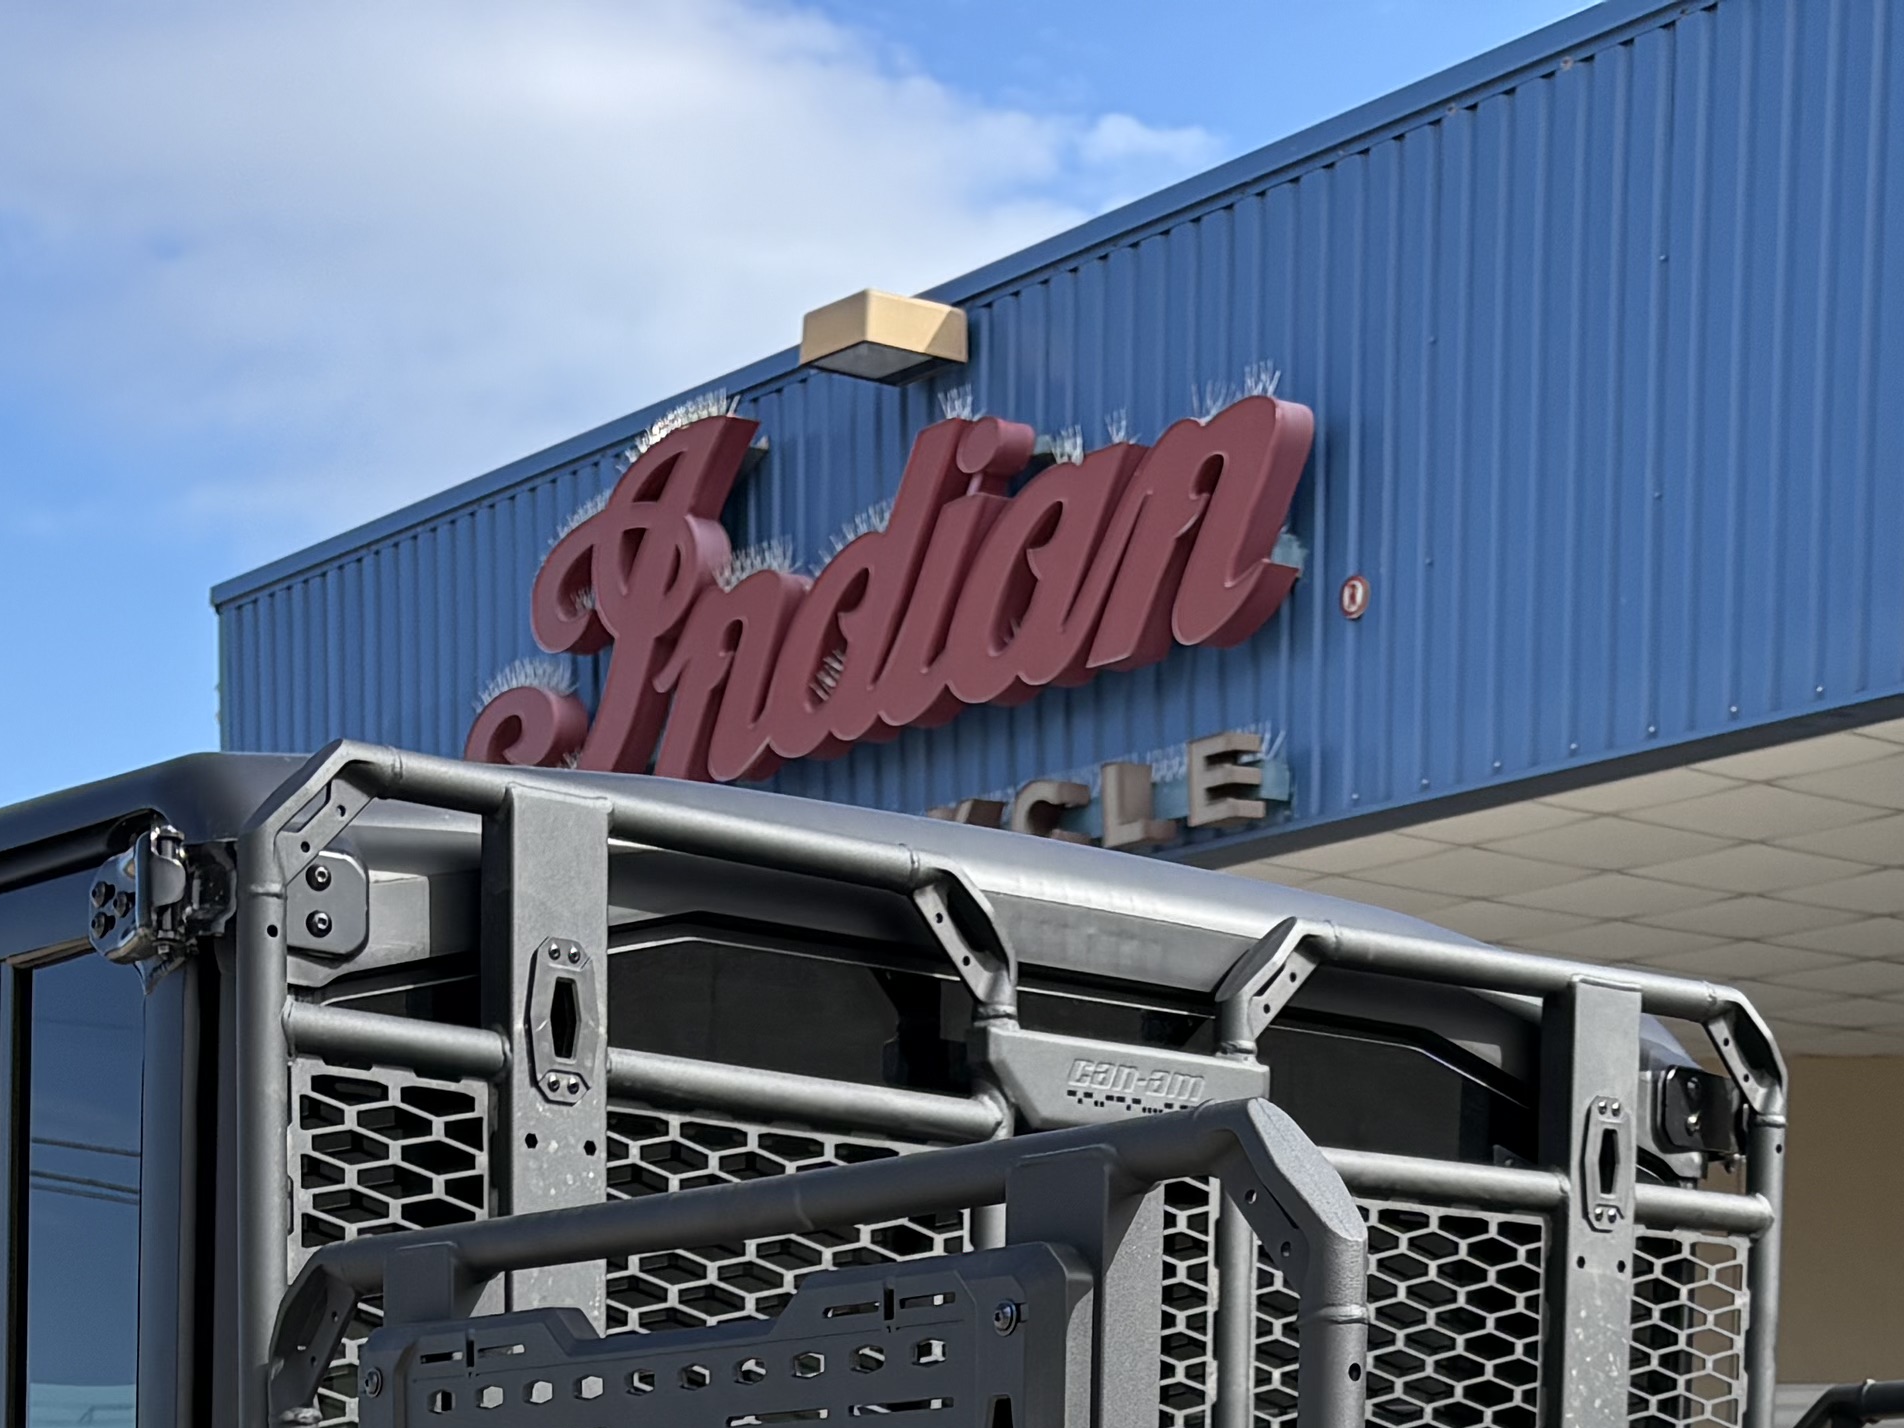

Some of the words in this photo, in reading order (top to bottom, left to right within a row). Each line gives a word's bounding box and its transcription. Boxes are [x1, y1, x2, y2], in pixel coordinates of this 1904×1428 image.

[463, 394, 1315, 783] Indian
[927, 731, 1268, 850] CLE
[1067, 1057, 1207, 1102] can-am
